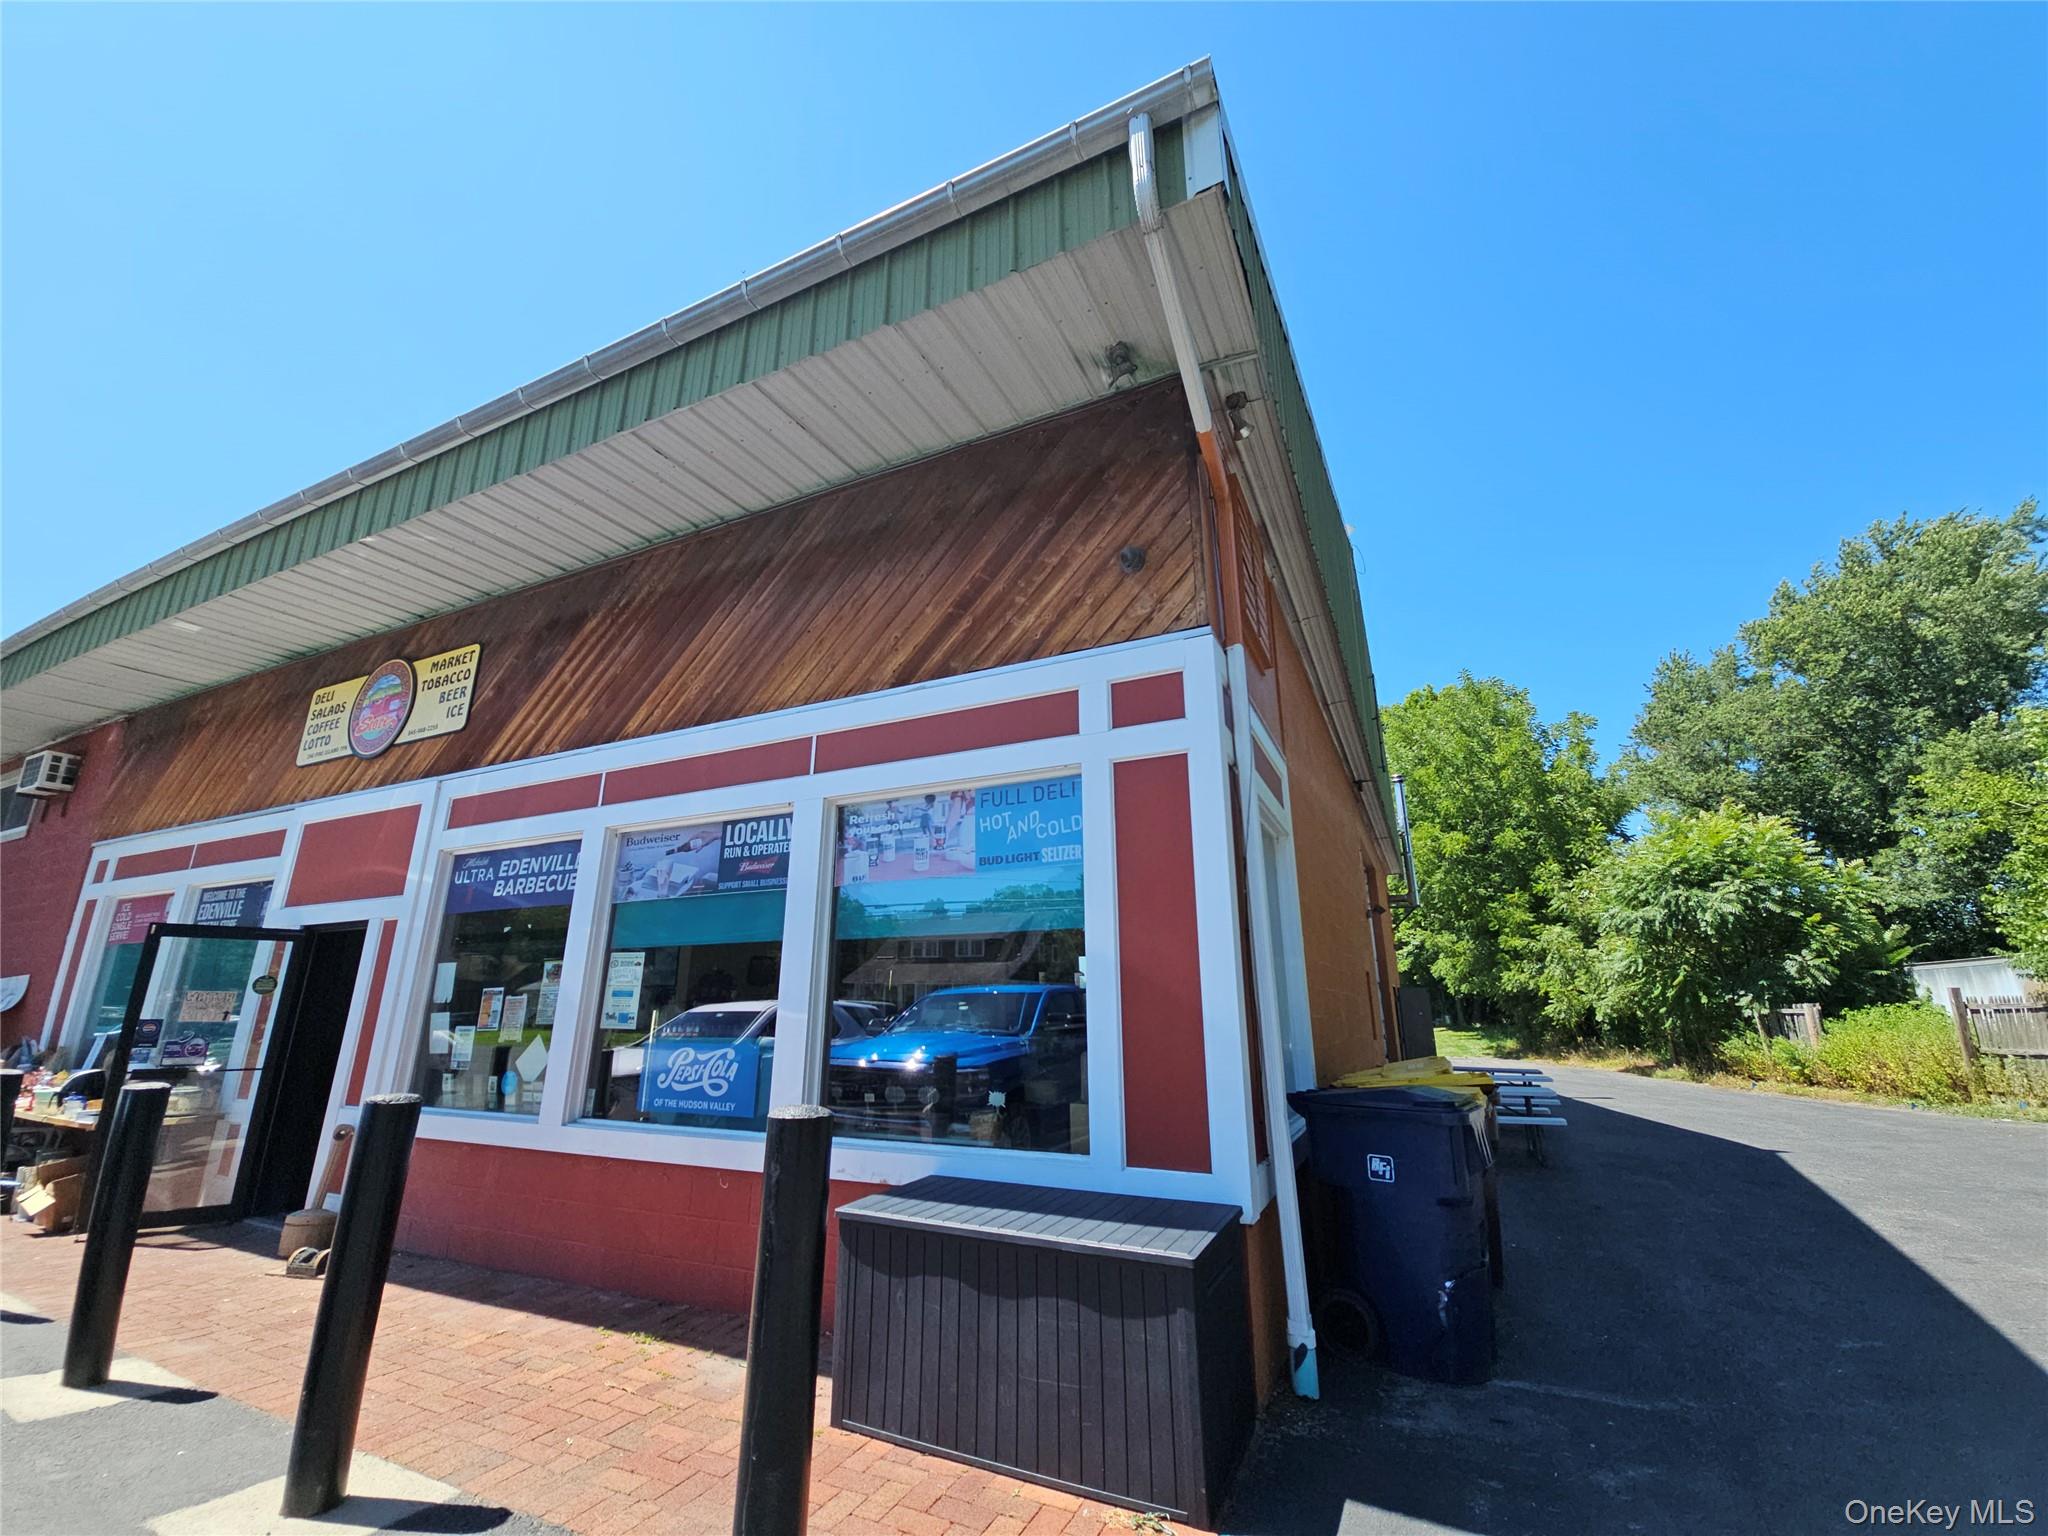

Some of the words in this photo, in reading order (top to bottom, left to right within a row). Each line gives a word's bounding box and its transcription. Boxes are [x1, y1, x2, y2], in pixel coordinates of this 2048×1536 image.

[430, 650, 476, 673] MARKET
[421, 668, 471, 692] TOBACCO
[315, 691, 335, 705] DELI
[439, 686, 467, 704] BEER
[310, 701, 347, 721] SALADS
[446, 703, 465, 719] ICE
[307, 717, 341, 736] COFFEE
[303, 734, 331, 751] LOTTO
[980, 787, 1027, 808] FULL
[1033, 781, 1076, 802] DELI
[725, 817, 793, 846] LOCALLY
[980, 811, 1012, 833] HOT
[1006, 810, 1039, 844] AND
[1036, 814, 1082, 838] COLD
[626, 832, 680, 847] Budweiser
[723, 846, 742, 859] RUN
[743, 846, 750, 857] &
[751, 841, 792, 856] OPERATE
[978, 855, 1004, 866] BUD
[1004, 851, 1041, 864] LIGHT
[1041, 844, 1082, 863] SELTZER
[454, 867, 494, 885] ULTRA
[493, 872, 577, 897] BARBECUE
[196, 900, 245, 921] EDENVILLE
[653, 1098, 663, 1107] OF
[664, 1098, 677, 1108] THE
[679, 1099, 709, 1110] HUDSON
[709, 1101, 737, 1112] VALLEY
